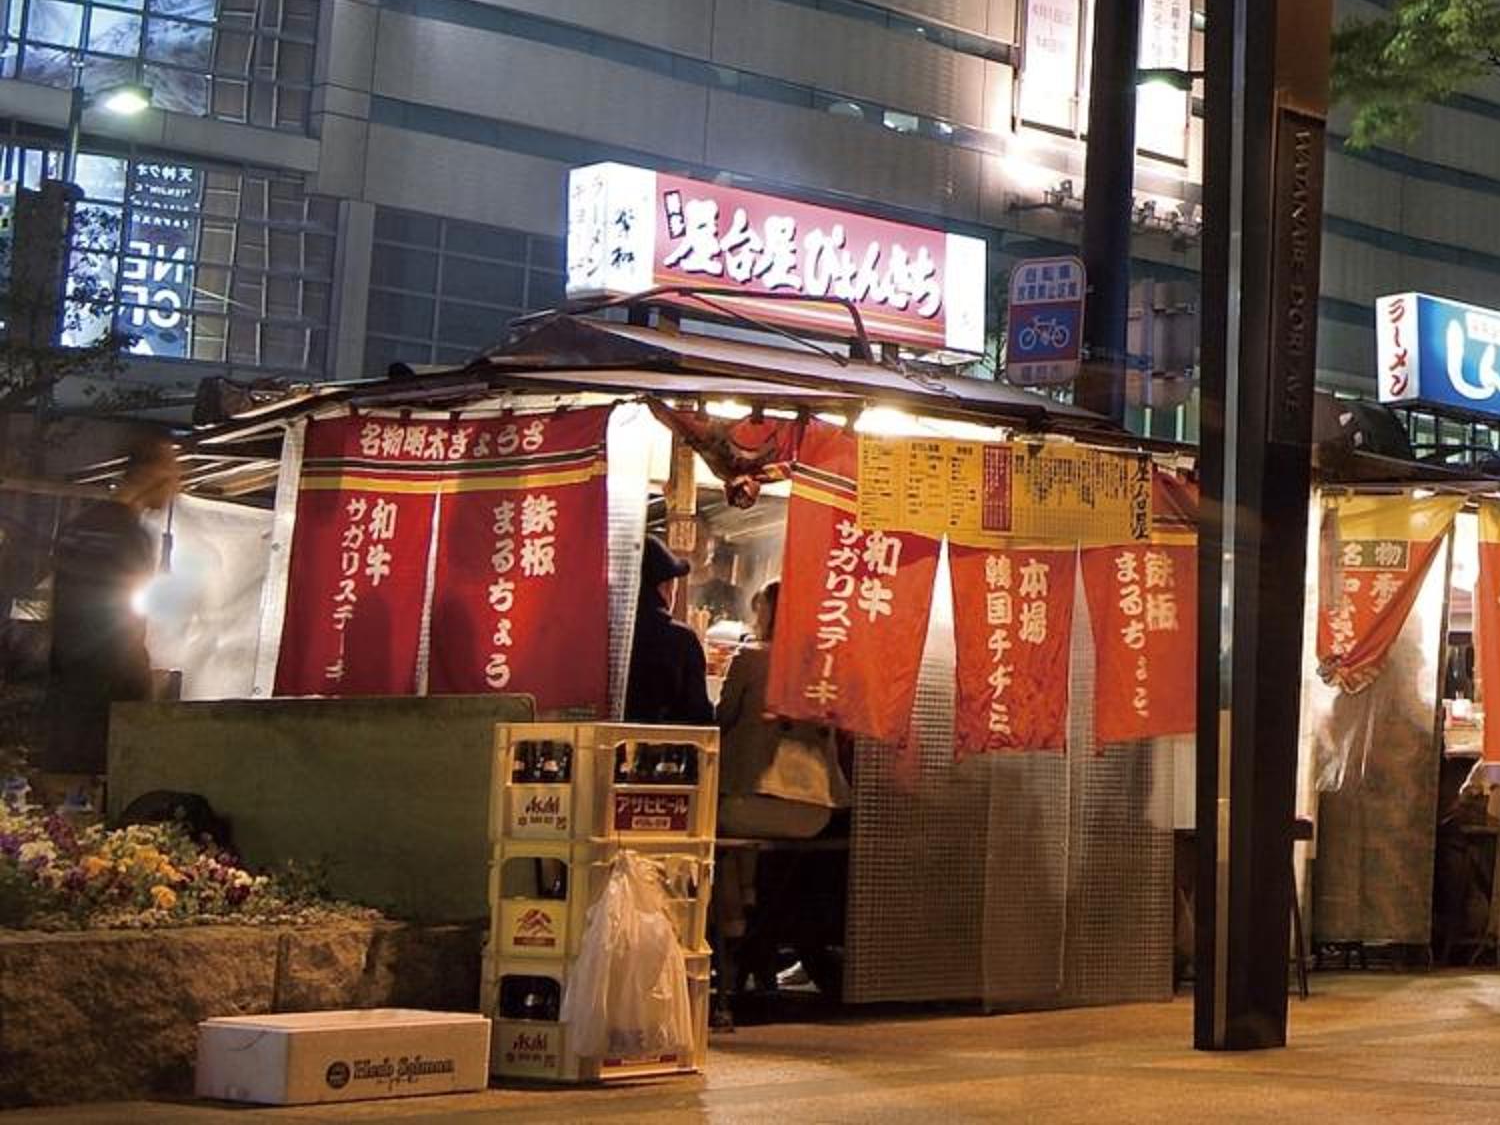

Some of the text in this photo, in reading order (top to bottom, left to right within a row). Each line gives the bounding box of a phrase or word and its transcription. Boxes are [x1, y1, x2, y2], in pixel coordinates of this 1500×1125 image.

[1388, 298, 1409, 397] ラーメン
[360, 418, 548, 459] 名物明太ぎょうざ
[364, 497, 399, 587] 和牛
[519, 493, 558, 577] 鉄板
[856, 530, 903, 622] 和牛
[1343, 542, 1403, 567] 名物
[985, 554, 1014, 736] 韓国チヂミ
[1018, 558, 1051, 645] 本場
[616, 795, 689, 816] アサヒビール
